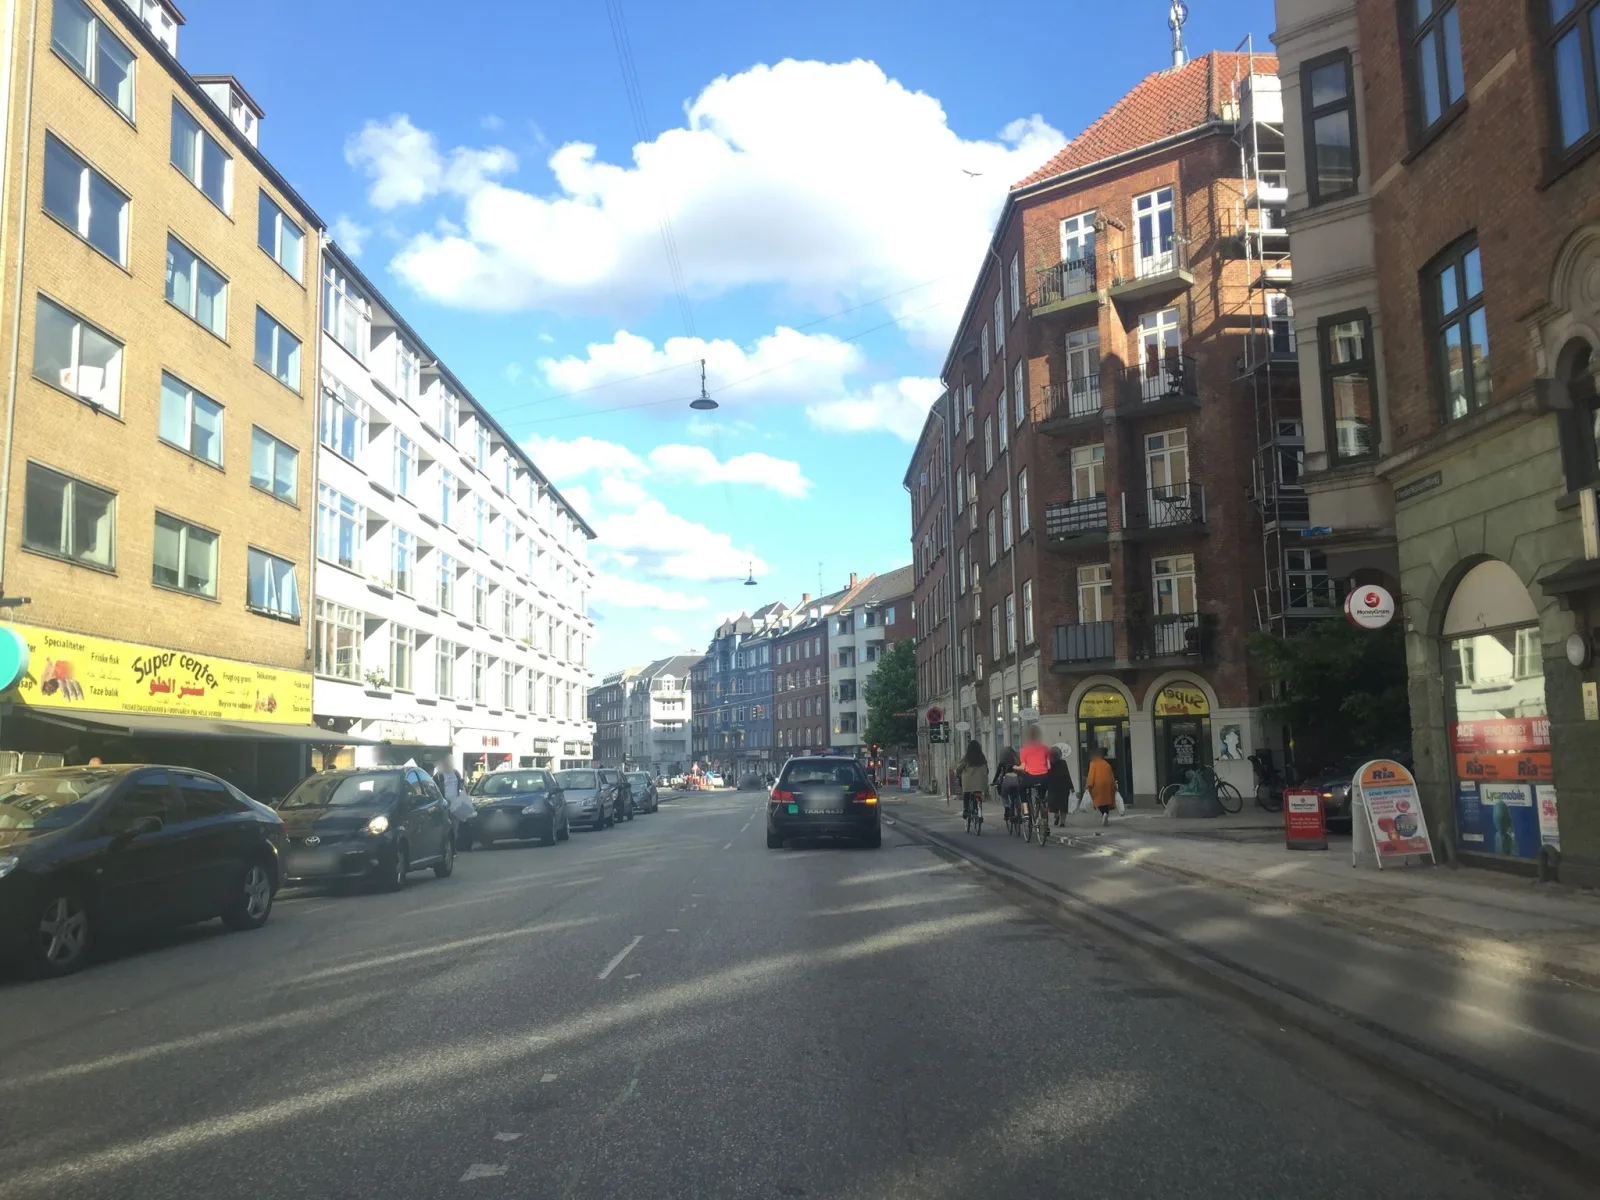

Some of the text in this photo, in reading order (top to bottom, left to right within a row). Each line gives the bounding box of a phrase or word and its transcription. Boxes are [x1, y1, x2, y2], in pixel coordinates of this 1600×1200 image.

[44, 635, 86, 652] Specialiteter
[91, 652, 120, 665] Friske fisk
[132, 653, 218, 689] Super center
[90, 685, 104, 696] Taze
[1372, 767, 1395, 780] Ria
[1466, 757, 1484, 775] Ria
[1518, 757, 1538, 776] Ria
[1486, 789, 1526, 801] Lycamobile
